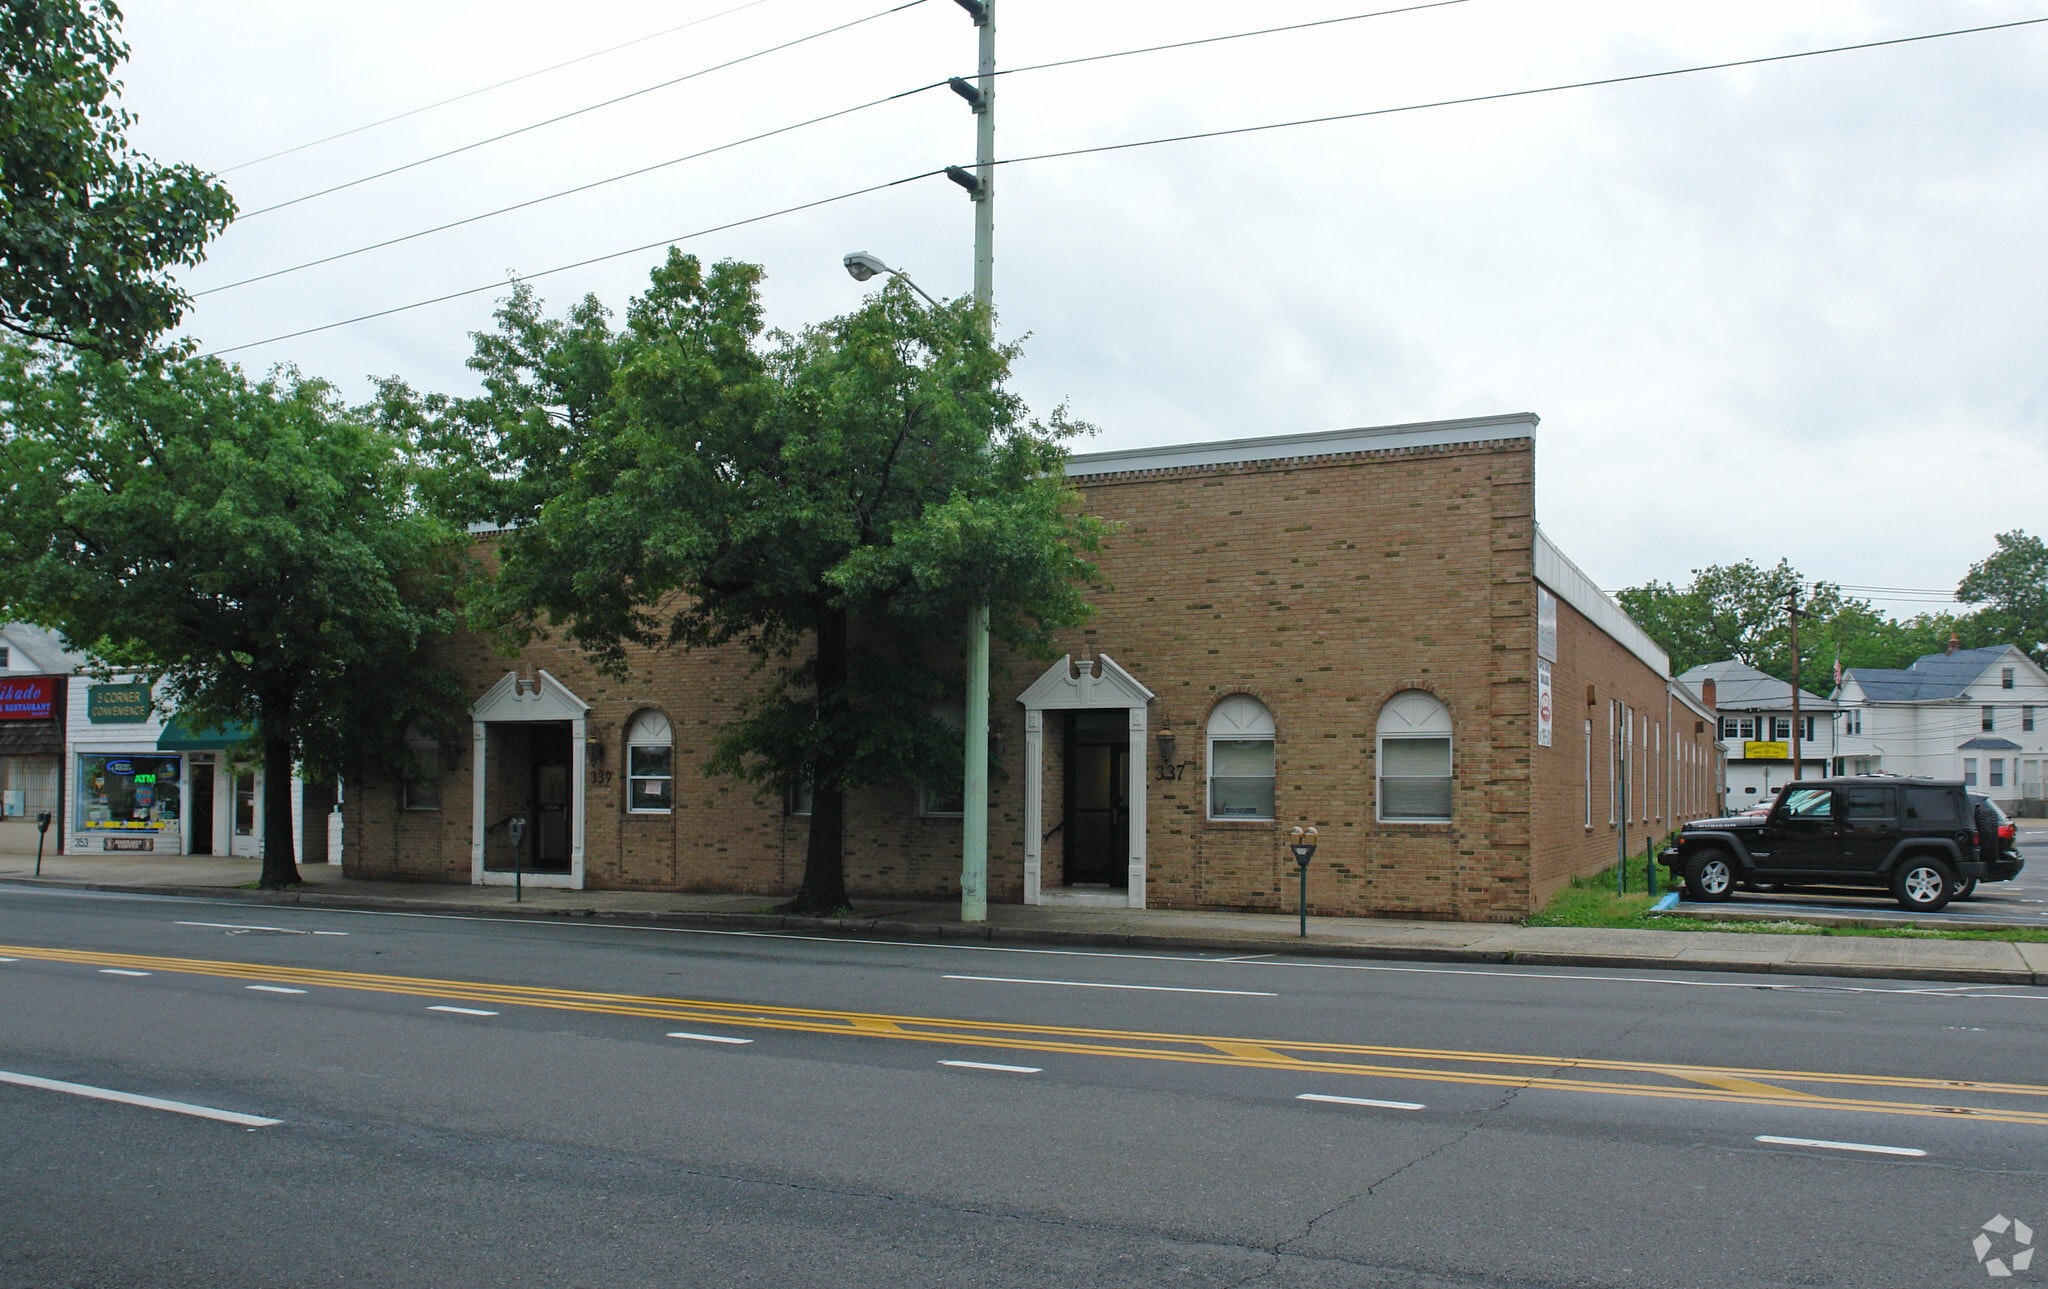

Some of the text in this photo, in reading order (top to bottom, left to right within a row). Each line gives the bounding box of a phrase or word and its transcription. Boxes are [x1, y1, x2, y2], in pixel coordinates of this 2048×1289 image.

[0, 684, 42, 700] ikado
[104, 691, 141, 704] CORNER
[5, 702, 51, 712] RESTAURANT
[91, 705, 145, 717] CONVENIENCE
[134, 773, 156, 784] ATM
[590, 770, 613, 784] 339
[1155, 764, 1186, 781] 337
[75, 838, 89, 848] 353
